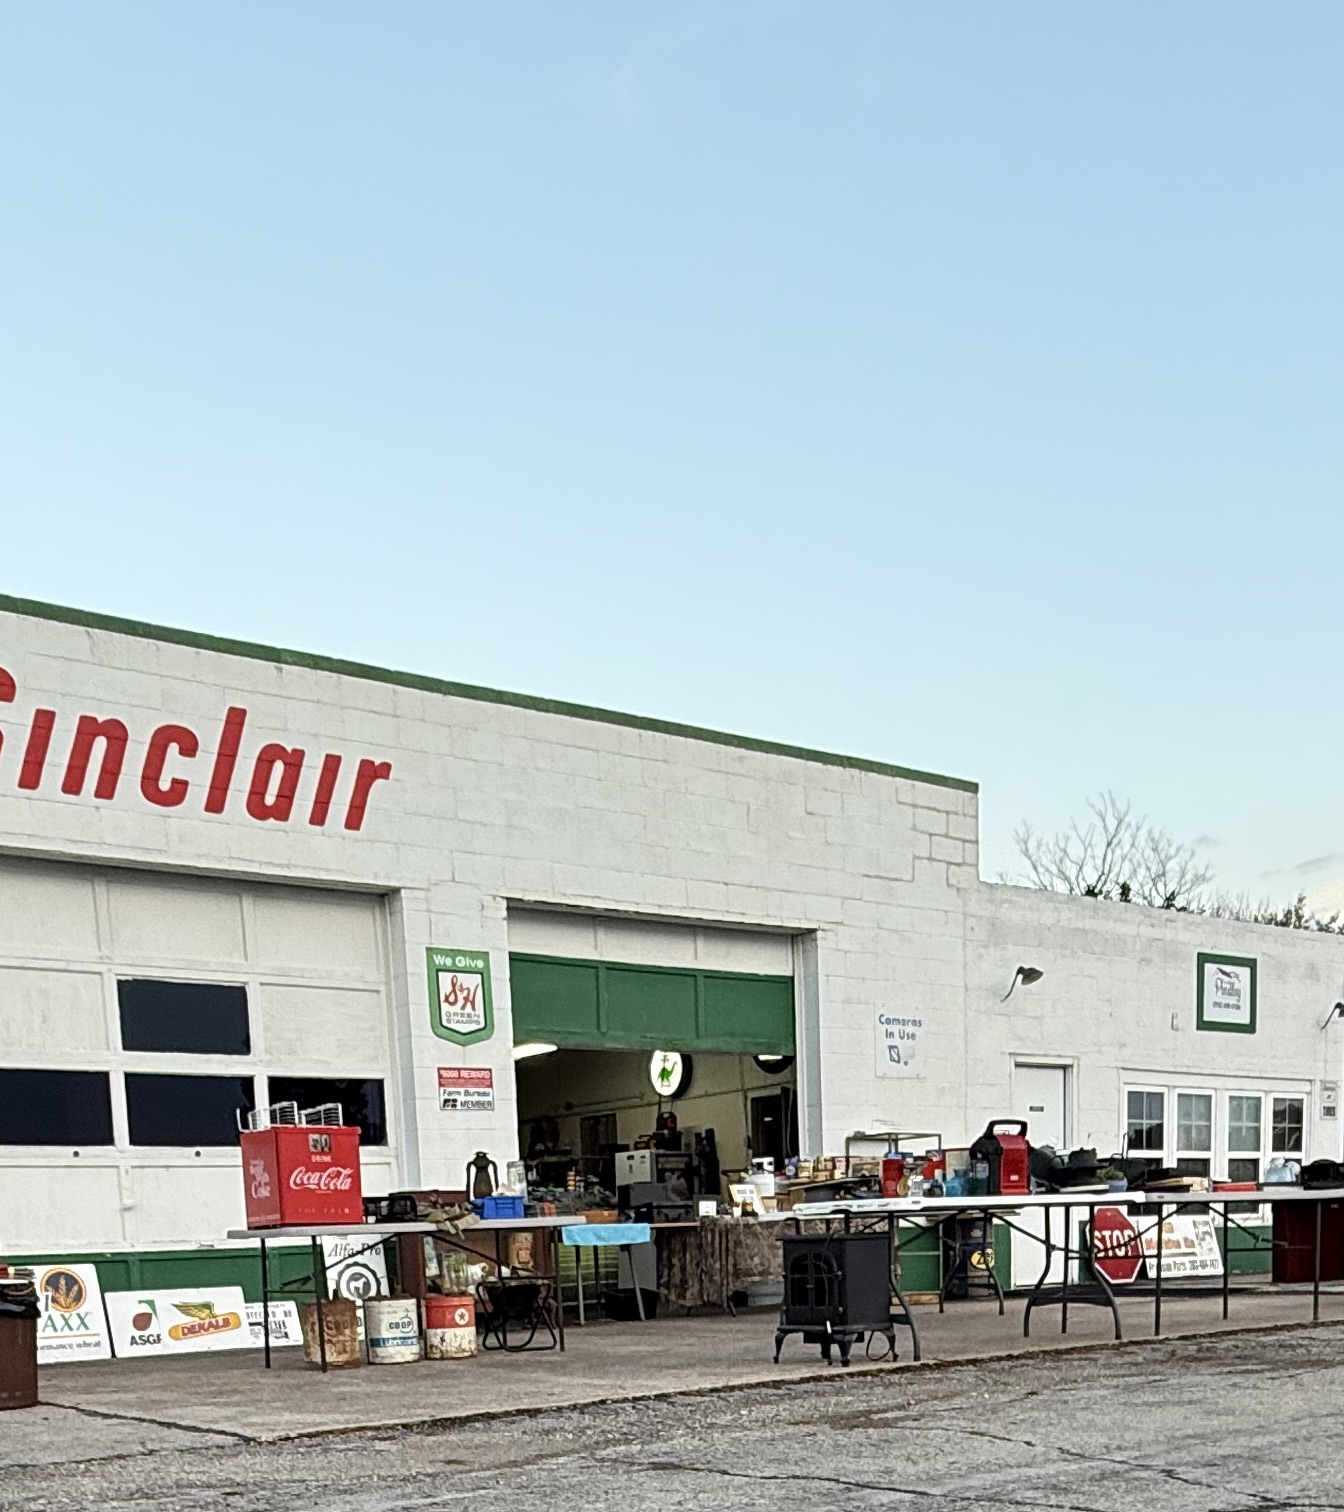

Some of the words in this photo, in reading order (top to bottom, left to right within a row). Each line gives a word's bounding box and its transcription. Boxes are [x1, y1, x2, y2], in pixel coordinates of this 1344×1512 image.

[433, 954, 453, 967] We
[455, 956, 484, 969] Give
[445, 1011, 481, 1020] GREEN
[446, 1018, 481, 1026] STAMPS
[878, 1013, 923, 1028] Cameras
[885, 1028, 895, 1039] In
[898, 1029, 917, 1041] Use
[1094, 1229, 1135, 1258] STOP
[42, 1312, 91, 1333] AXX
[180, 1317, 232, 1338] DEKALB
